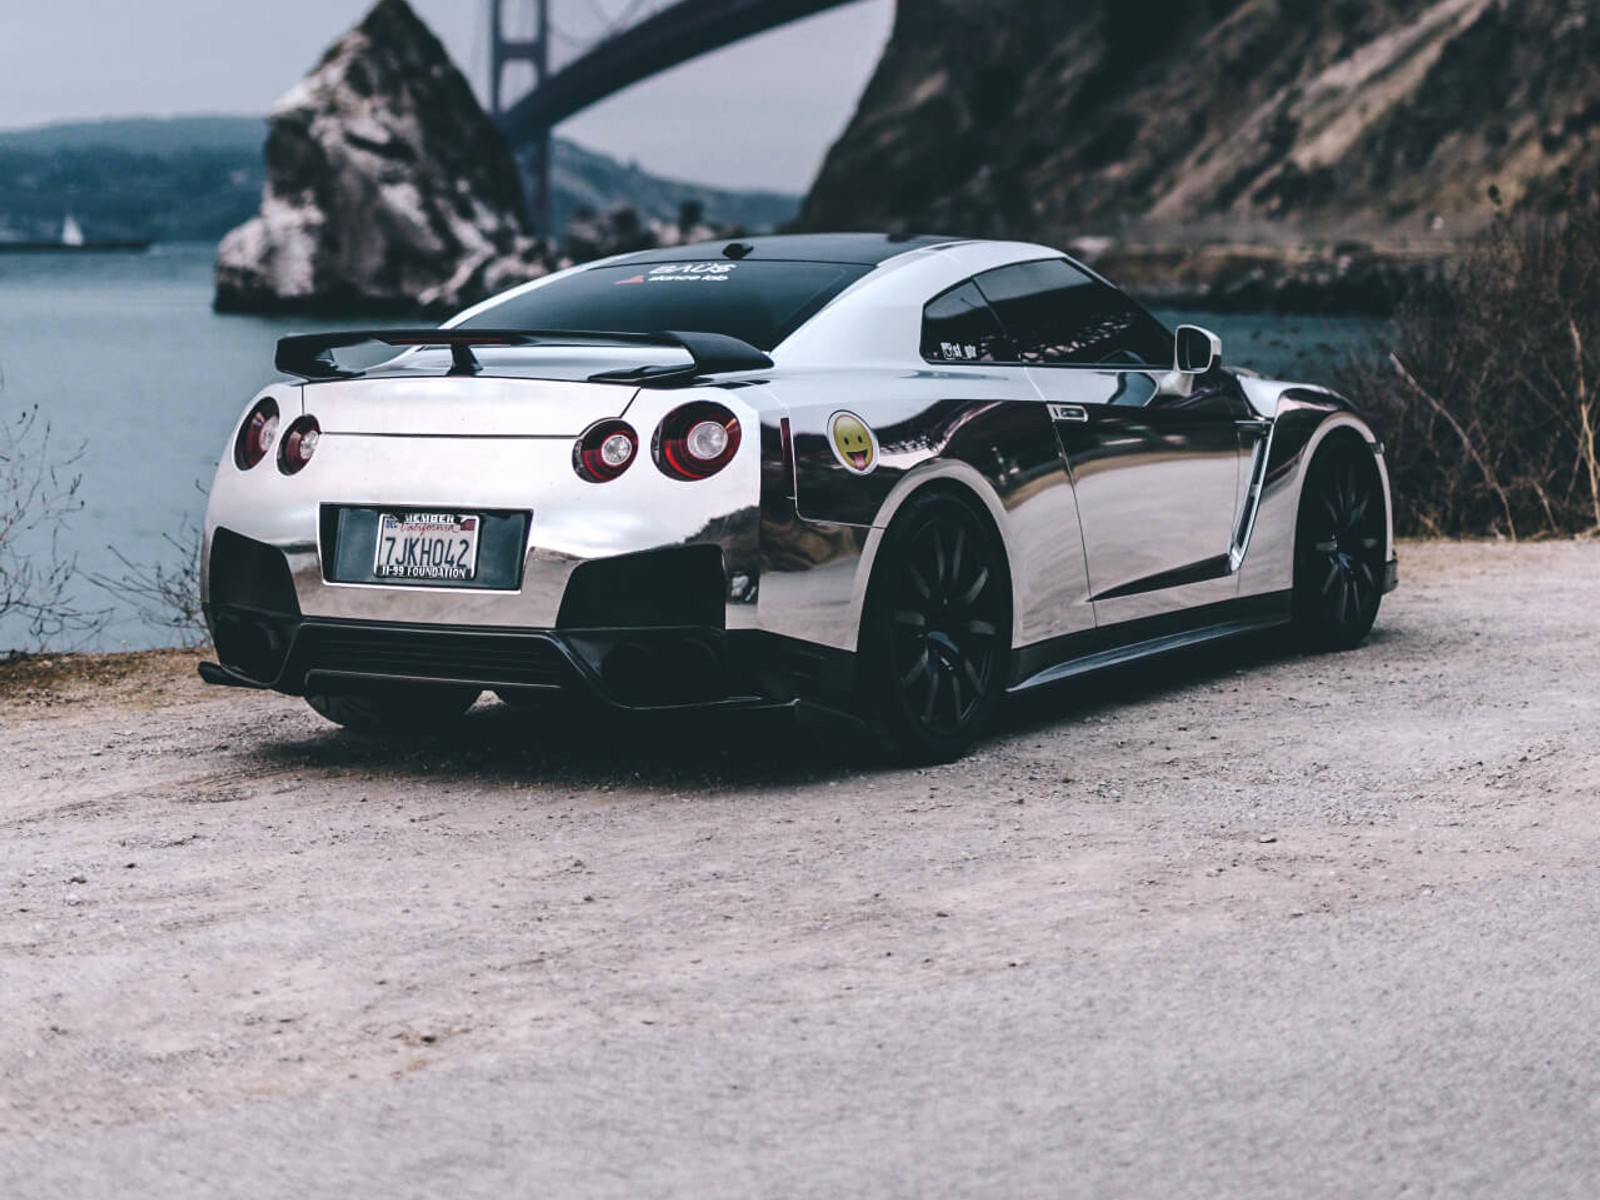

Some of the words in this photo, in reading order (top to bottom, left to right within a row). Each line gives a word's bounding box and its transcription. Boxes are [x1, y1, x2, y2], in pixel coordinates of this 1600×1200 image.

[404, 513, 455, 523] MEMBER
[400, 523, 460, 536] California
[385, 537, 469, 568] 7JKH042
[407, 567, 466, 578] FOUNDATION
